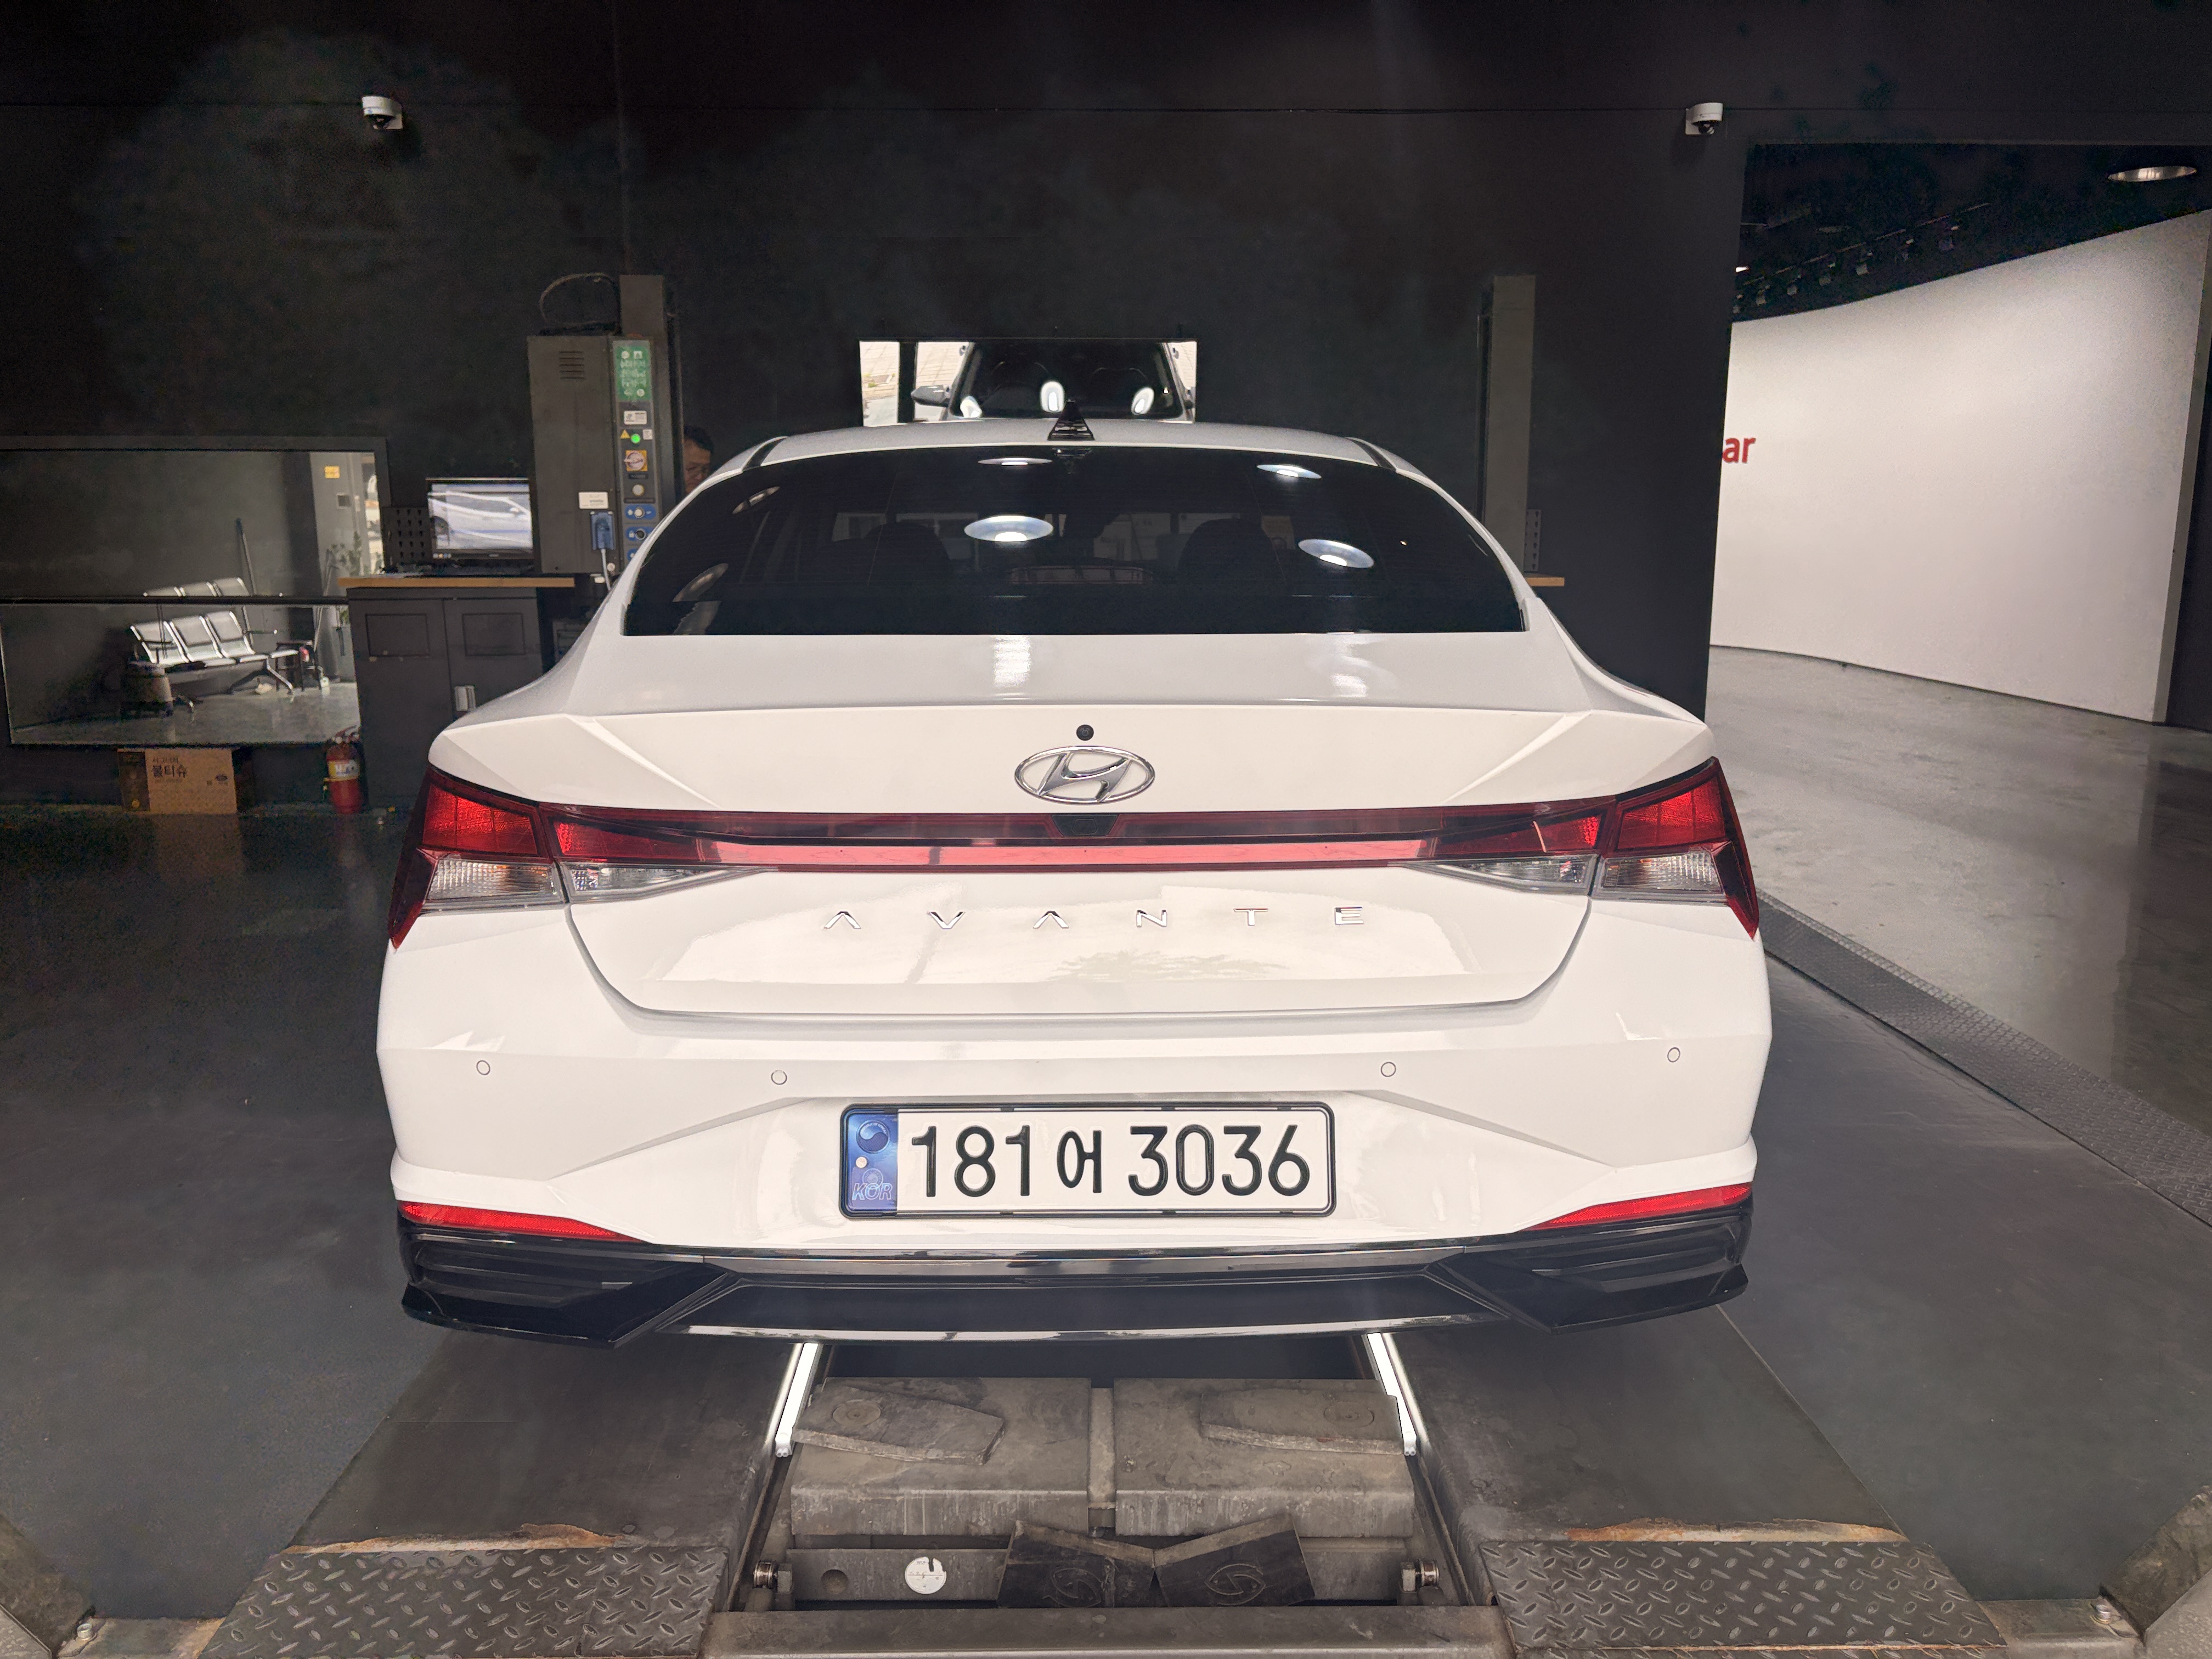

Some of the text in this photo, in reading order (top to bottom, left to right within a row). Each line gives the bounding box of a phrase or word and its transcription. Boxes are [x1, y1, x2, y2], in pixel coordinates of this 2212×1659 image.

[1722, 437, 1756, 464] ar
[823, 907, 1364, 929] AVANTE
[912, 1124, 1310, 1198] 181어 3036
[852, 1183, 893, 1200] KOR
